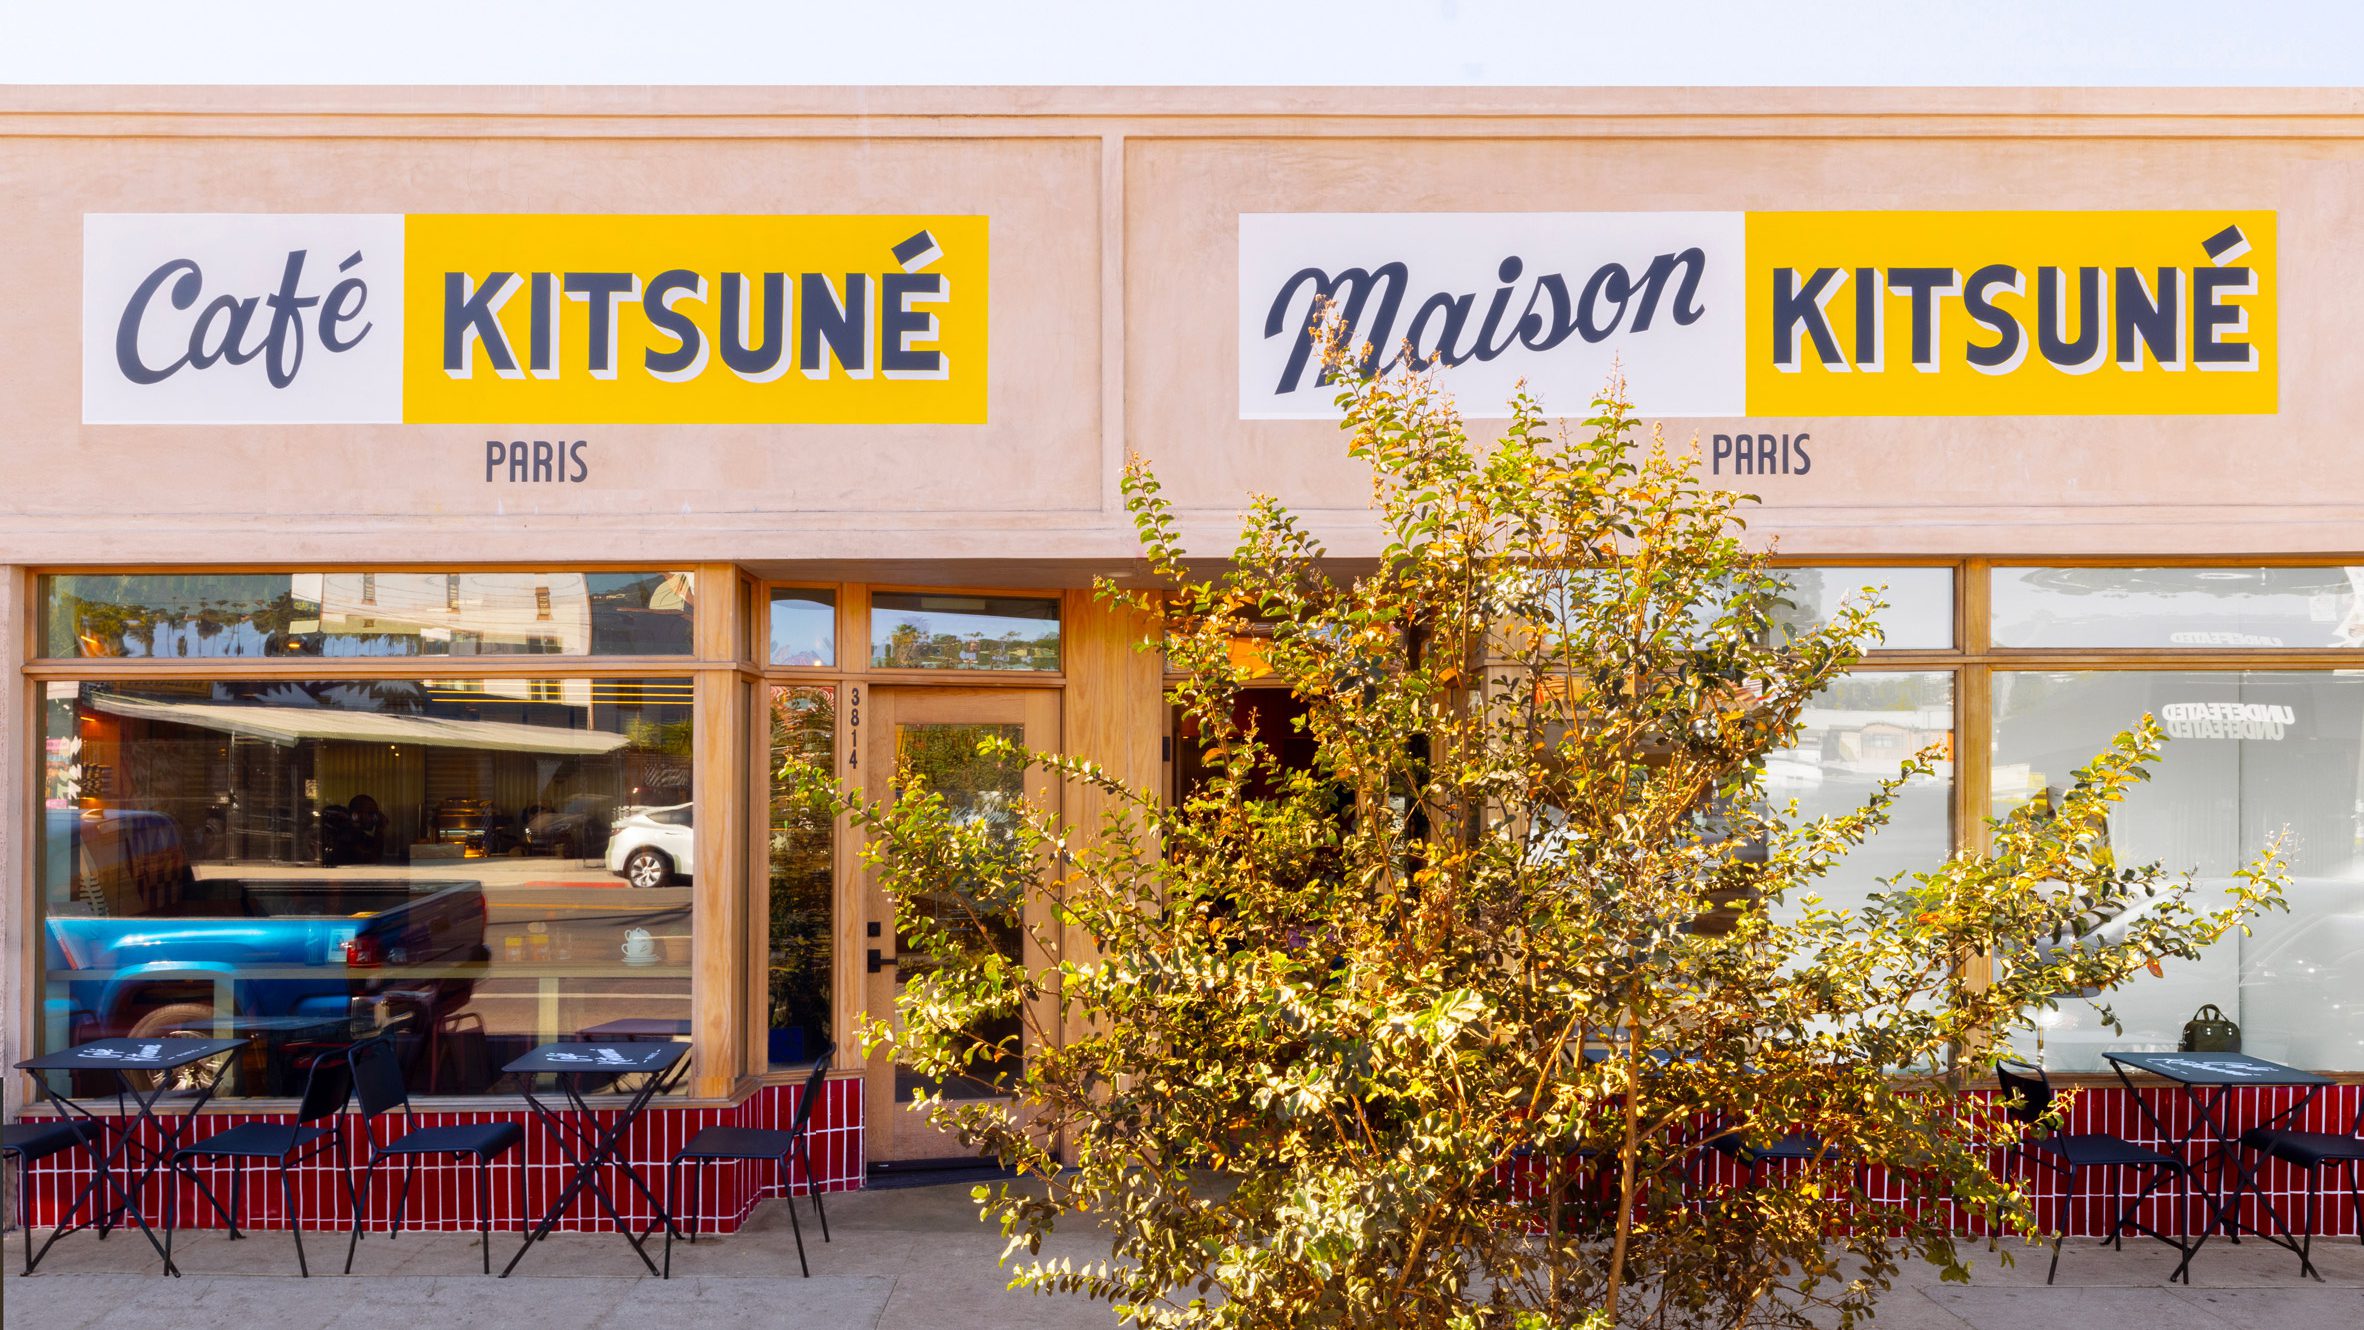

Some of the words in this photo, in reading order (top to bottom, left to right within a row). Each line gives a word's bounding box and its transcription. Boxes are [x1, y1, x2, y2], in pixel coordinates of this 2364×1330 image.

[116, 249, 373, 389] Café
[443, 229, 951, 385] KITSUNÉ
[1264, 247, 1706, 395] Maison
[1773, 223, 2260, 377] KITSUNÉ
[486, 440, 588, 483] PARIS
[1713, 433, 1811, 476] PARIS
[849, 687, 860, 770] 3814
